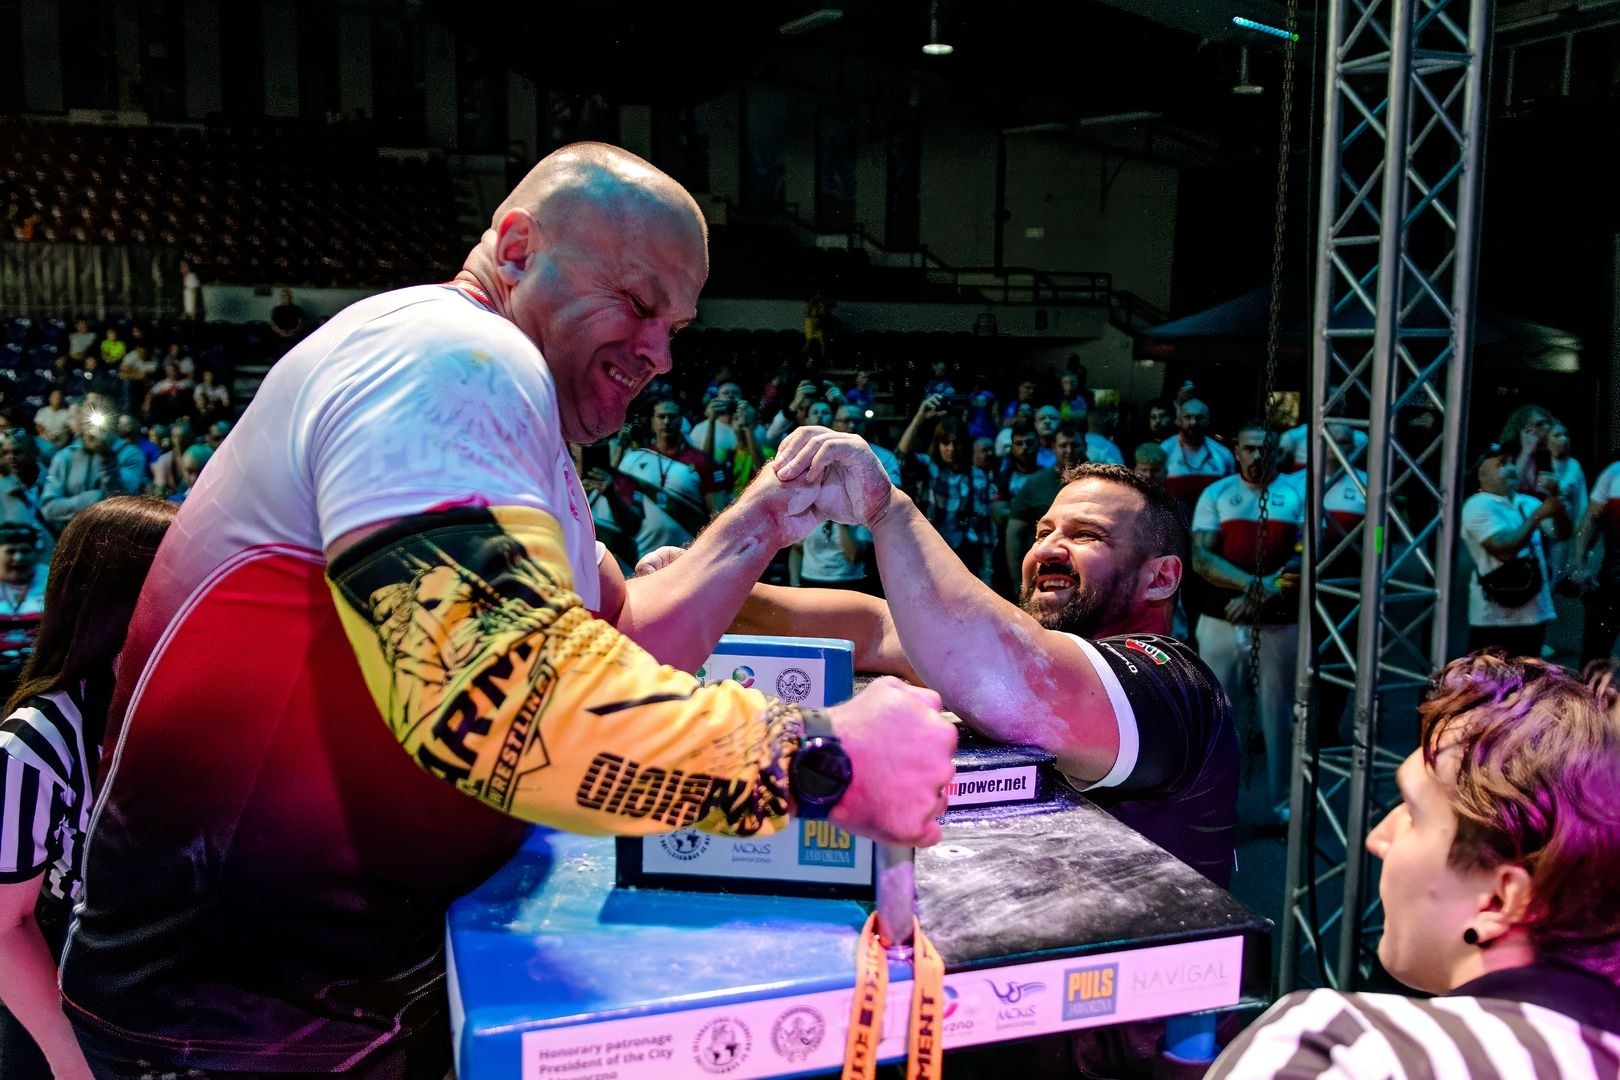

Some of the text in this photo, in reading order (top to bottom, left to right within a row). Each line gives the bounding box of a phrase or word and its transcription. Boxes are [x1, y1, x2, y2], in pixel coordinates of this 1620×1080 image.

[804, 819, 851, 849] PULS
[1068, 968, 1114, 1002] PULS
[539, 1033, 672, 1060] Honorary patronage
[539, 1047, 673, 1074] President of the City
